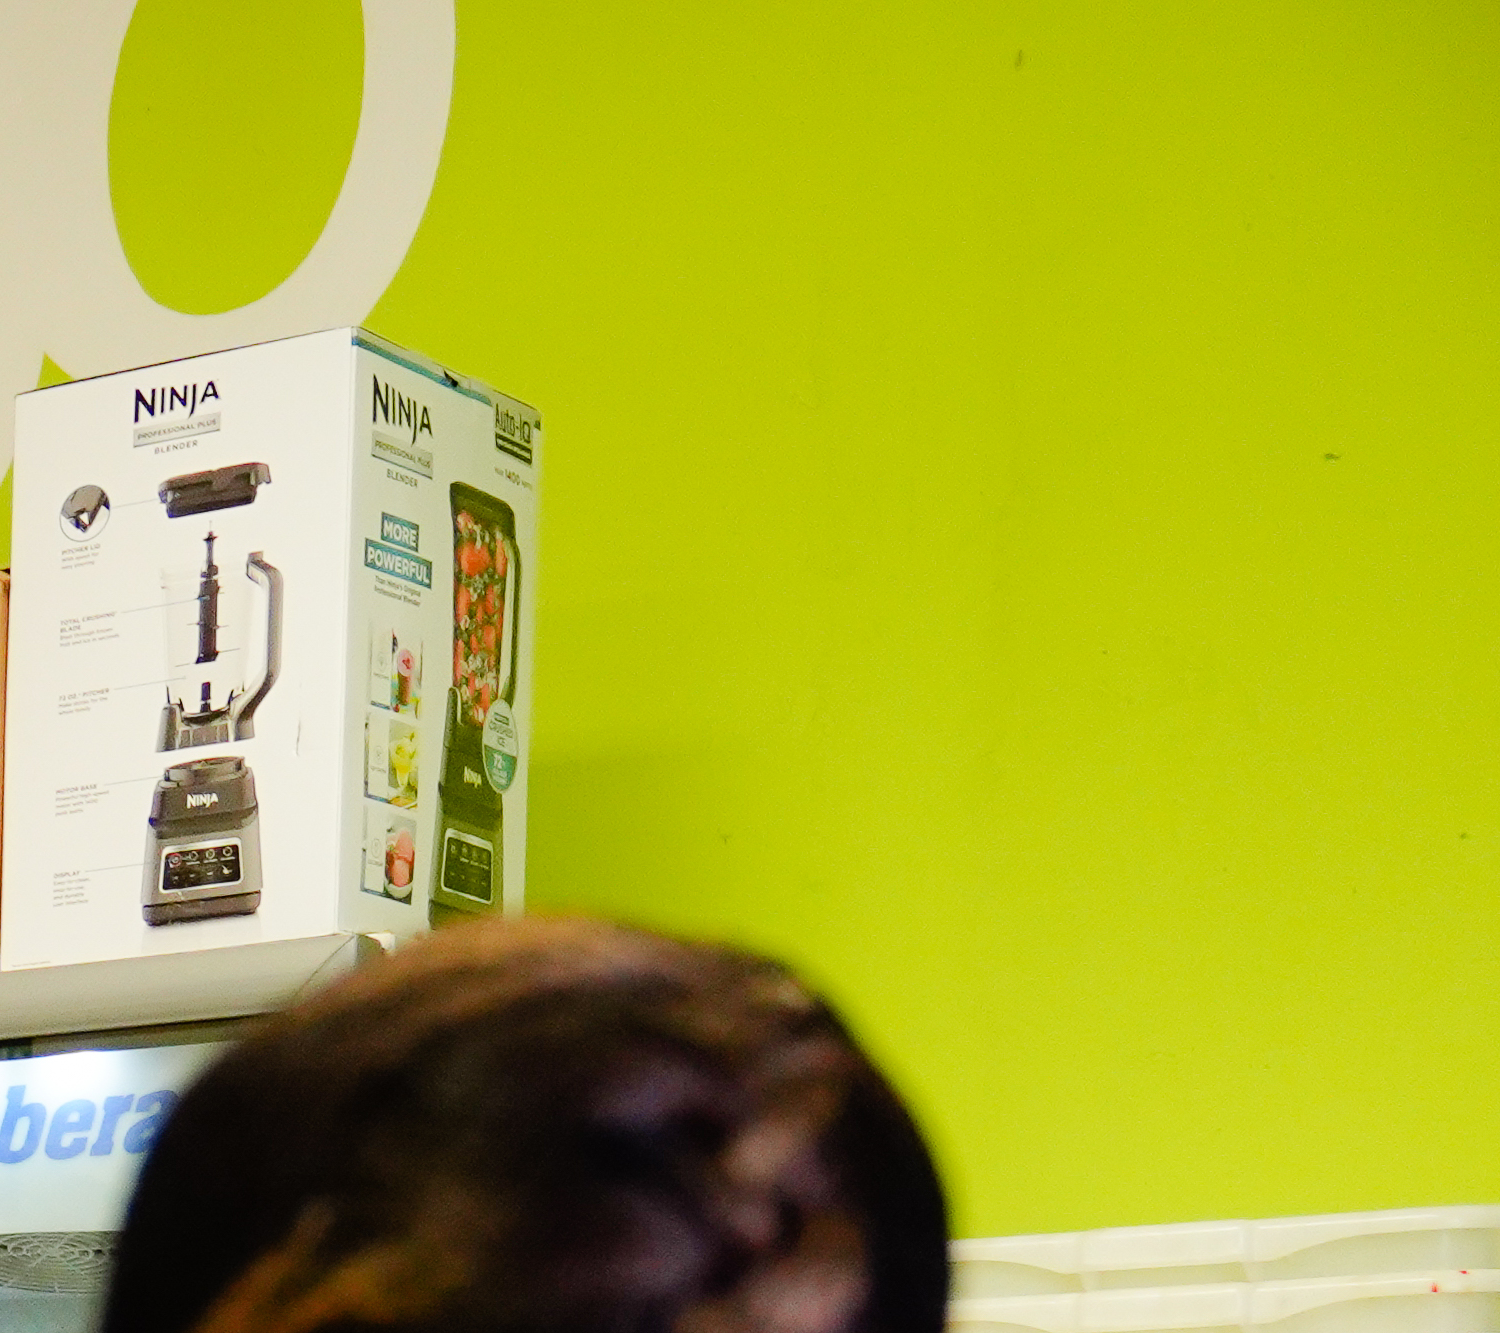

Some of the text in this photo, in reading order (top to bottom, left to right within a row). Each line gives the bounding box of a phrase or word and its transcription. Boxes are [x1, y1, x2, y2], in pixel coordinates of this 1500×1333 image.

[133, 380, 221, 424] NINJA
[372, 373, 434, 446] NINJA
[136, 422, 196, 441] PROFESSIONAL
[153, 439, 199, 455] BLENDER
[386, 468, 419, 489] BLENDER
[382, 519, 417, 549] MORE
[366, 546, 431, 585] POWERFUL
[186, 792, 219, 809] NINJA
